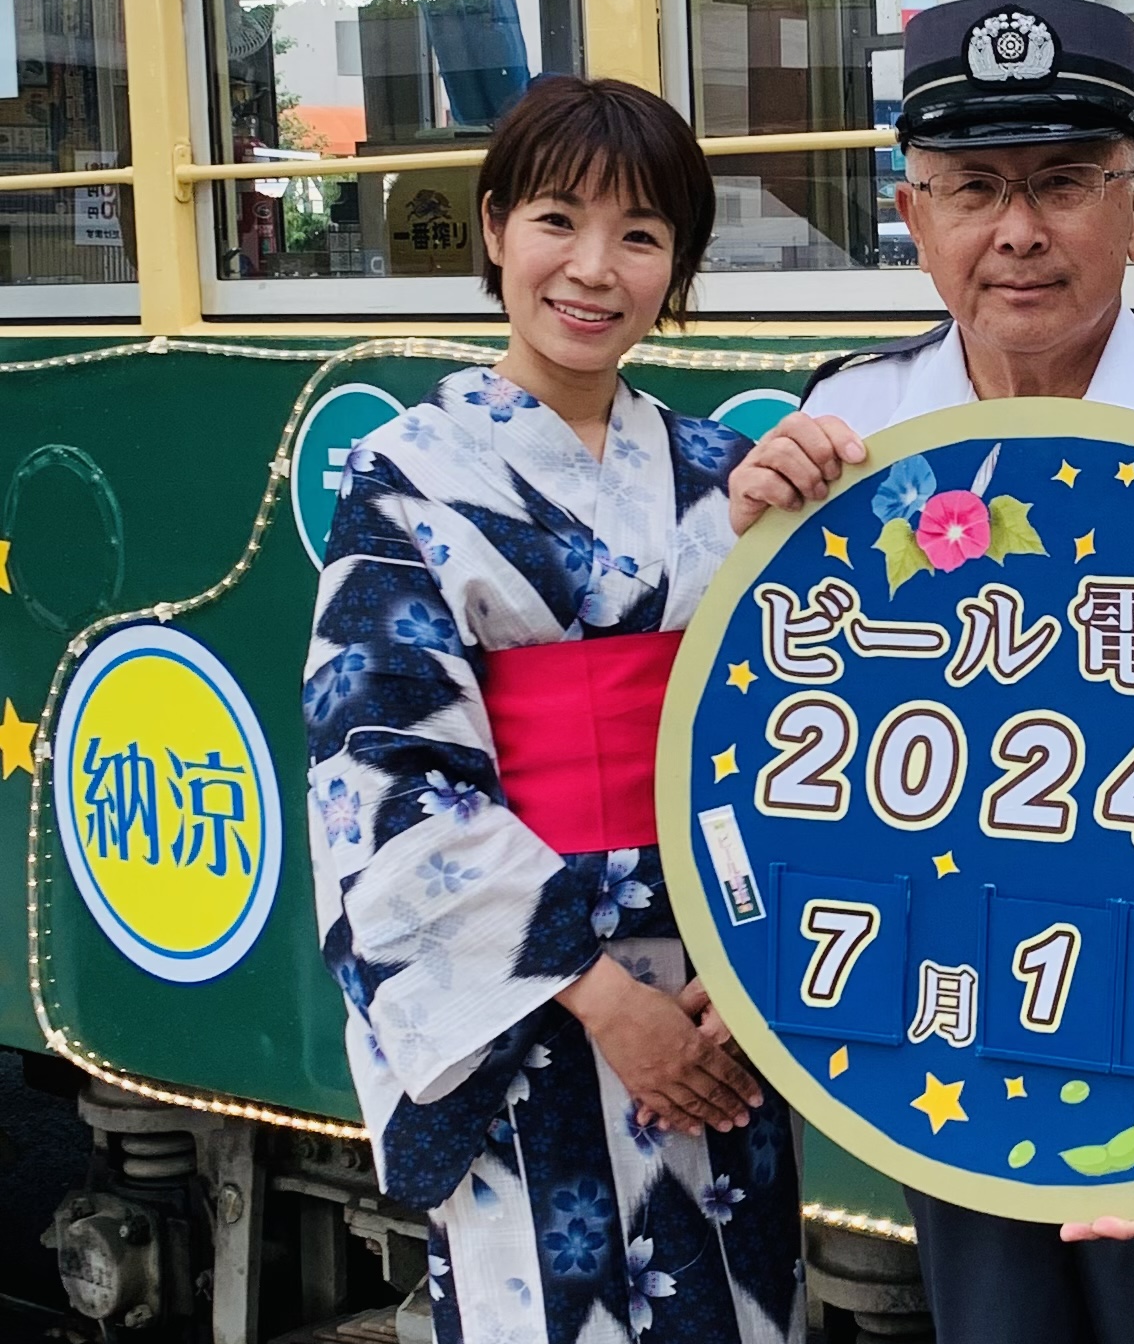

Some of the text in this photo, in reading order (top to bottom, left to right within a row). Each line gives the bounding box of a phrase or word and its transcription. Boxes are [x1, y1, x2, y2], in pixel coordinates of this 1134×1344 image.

[393, 222, 468, 250] 一番搾り
[82, 736, 252, 878] 納涼
